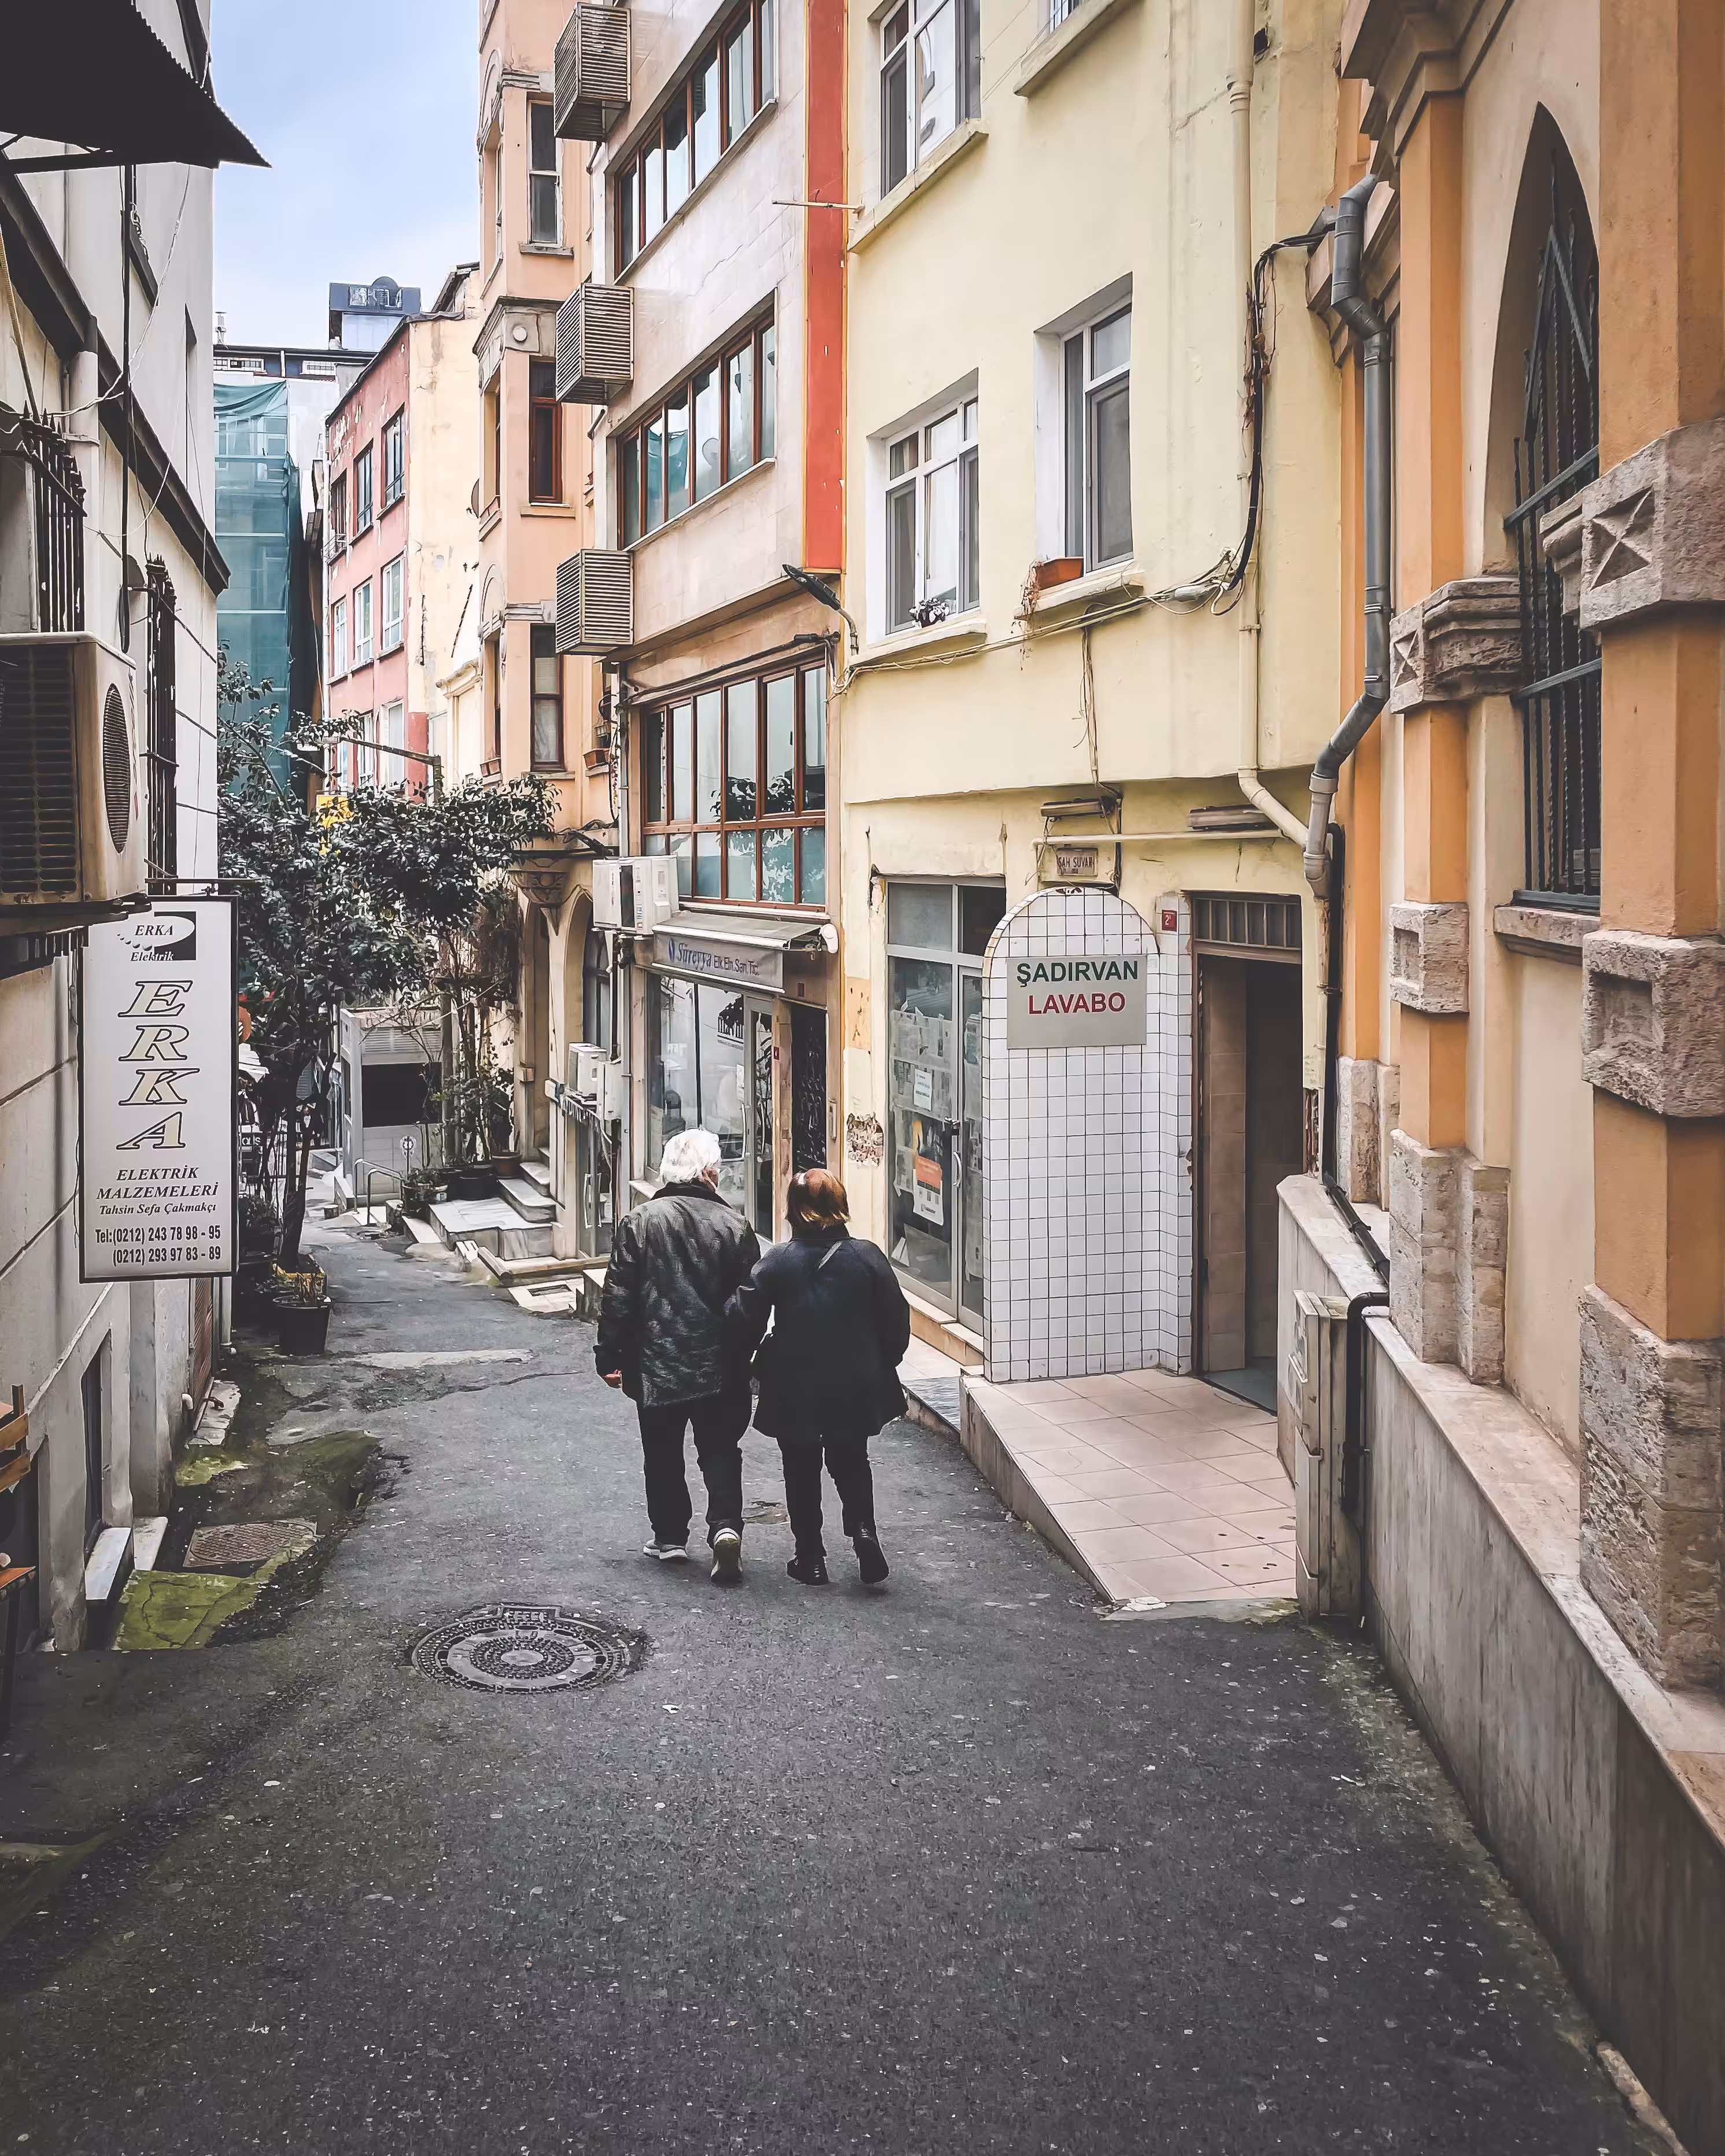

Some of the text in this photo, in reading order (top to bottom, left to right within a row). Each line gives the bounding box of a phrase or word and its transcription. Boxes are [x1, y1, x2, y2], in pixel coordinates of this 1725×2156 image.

[135, 925, 173, 936] ERKA
[130, 951, 174, 961] Elektrik
[1016, 960, 1138, 988] ŞADIRVAN
[1029, 992, 1125, 1015] LAVABO
[116, 1165, 199, 1181] ELEKTRİK
[96, 1182, 219, 1199] MALZEMELERİ
[100, 1202, 216, 1216] Tahsin Sefa Çakmakçı
[148, 1227, 167, 1242] 243
[170, 1227, 182, 1241] 78
[186, 1226, 198, 1240] 98
[209, 1225, 221, 1239] 95
[113, 1248, 145, 1267] (0212)
[148, 1248, 167, 1262] 293
[170, 1247, 183, 1261] 97
[186, 1247, 198, 1261] 83
[209, 1246, 221, 1260] 89
